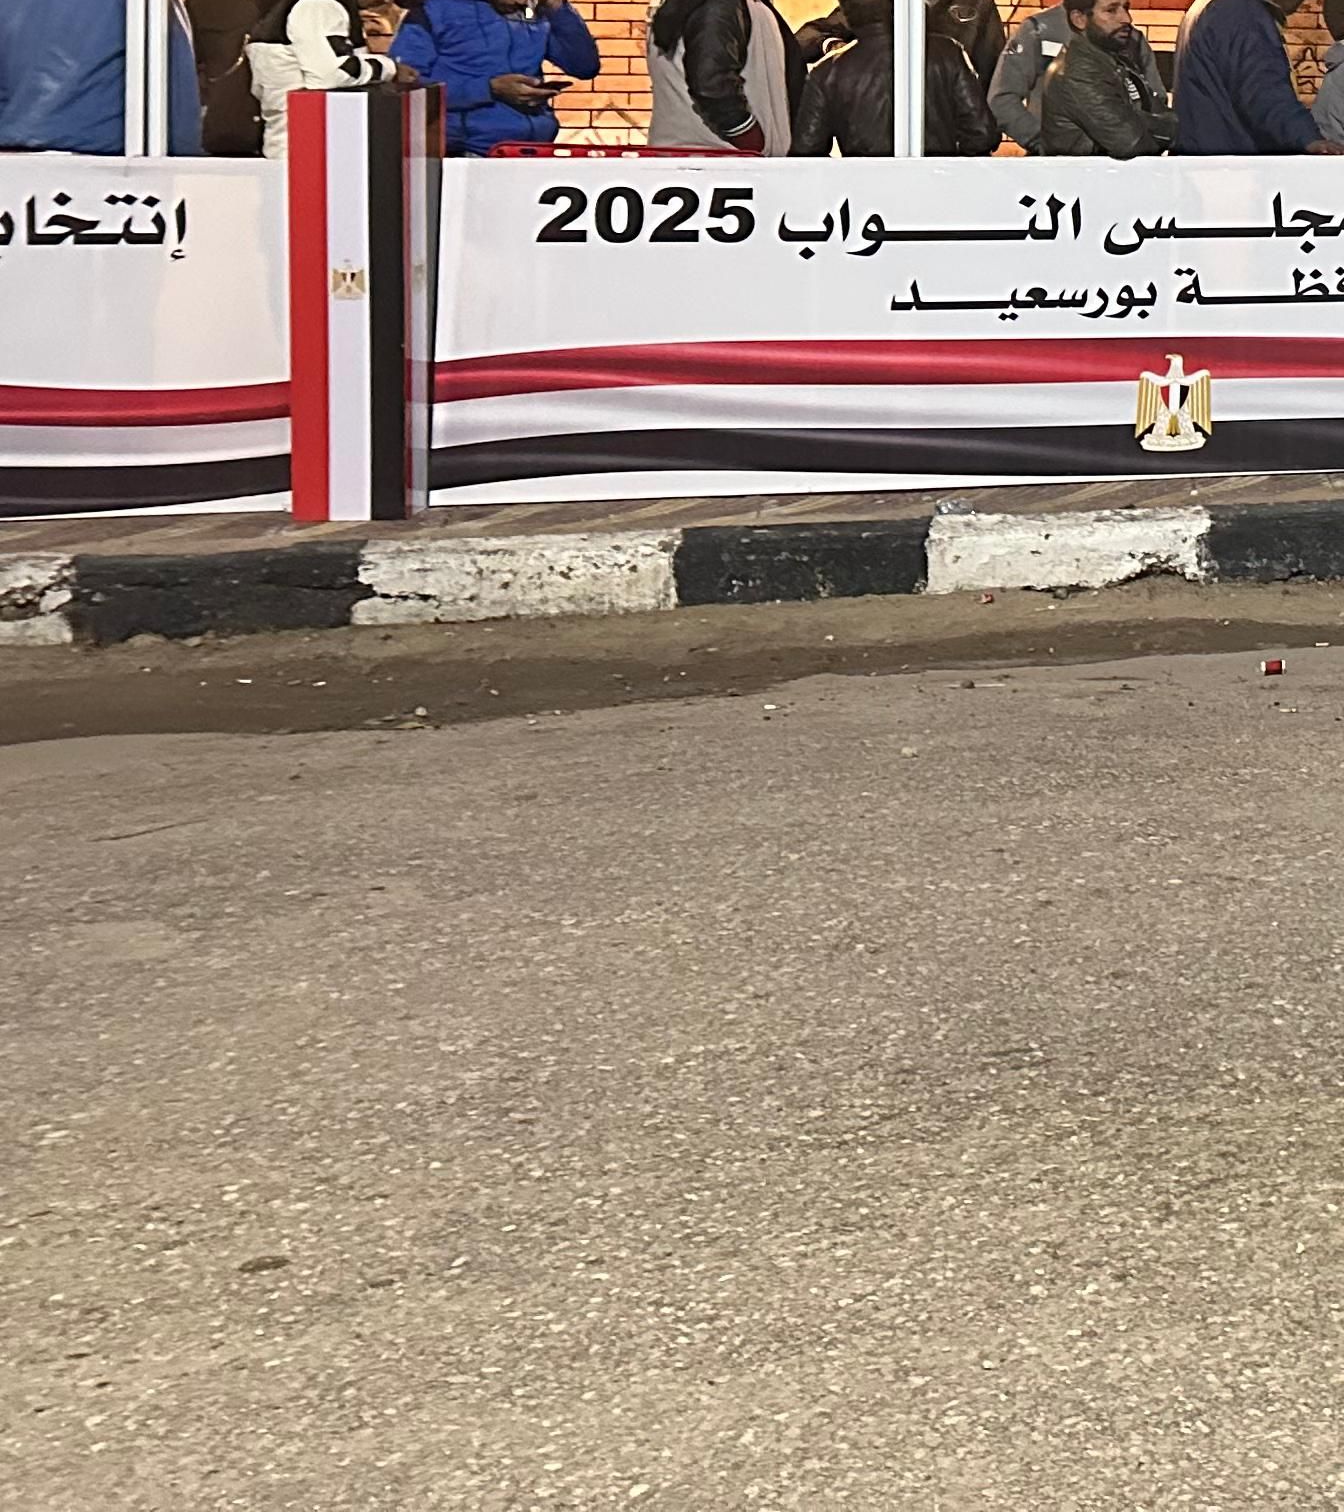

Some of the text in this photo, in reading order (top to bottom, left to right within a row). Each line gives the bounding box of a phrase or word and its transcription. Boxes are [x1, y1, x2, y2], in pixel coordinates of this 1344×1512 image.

[0, 191, 187, 263] إنتخا
[535, 186, 756, 244] 2025
[778, 194, 1082, 260] النواب
[890, 279, 1158, 321] بورسعيد
